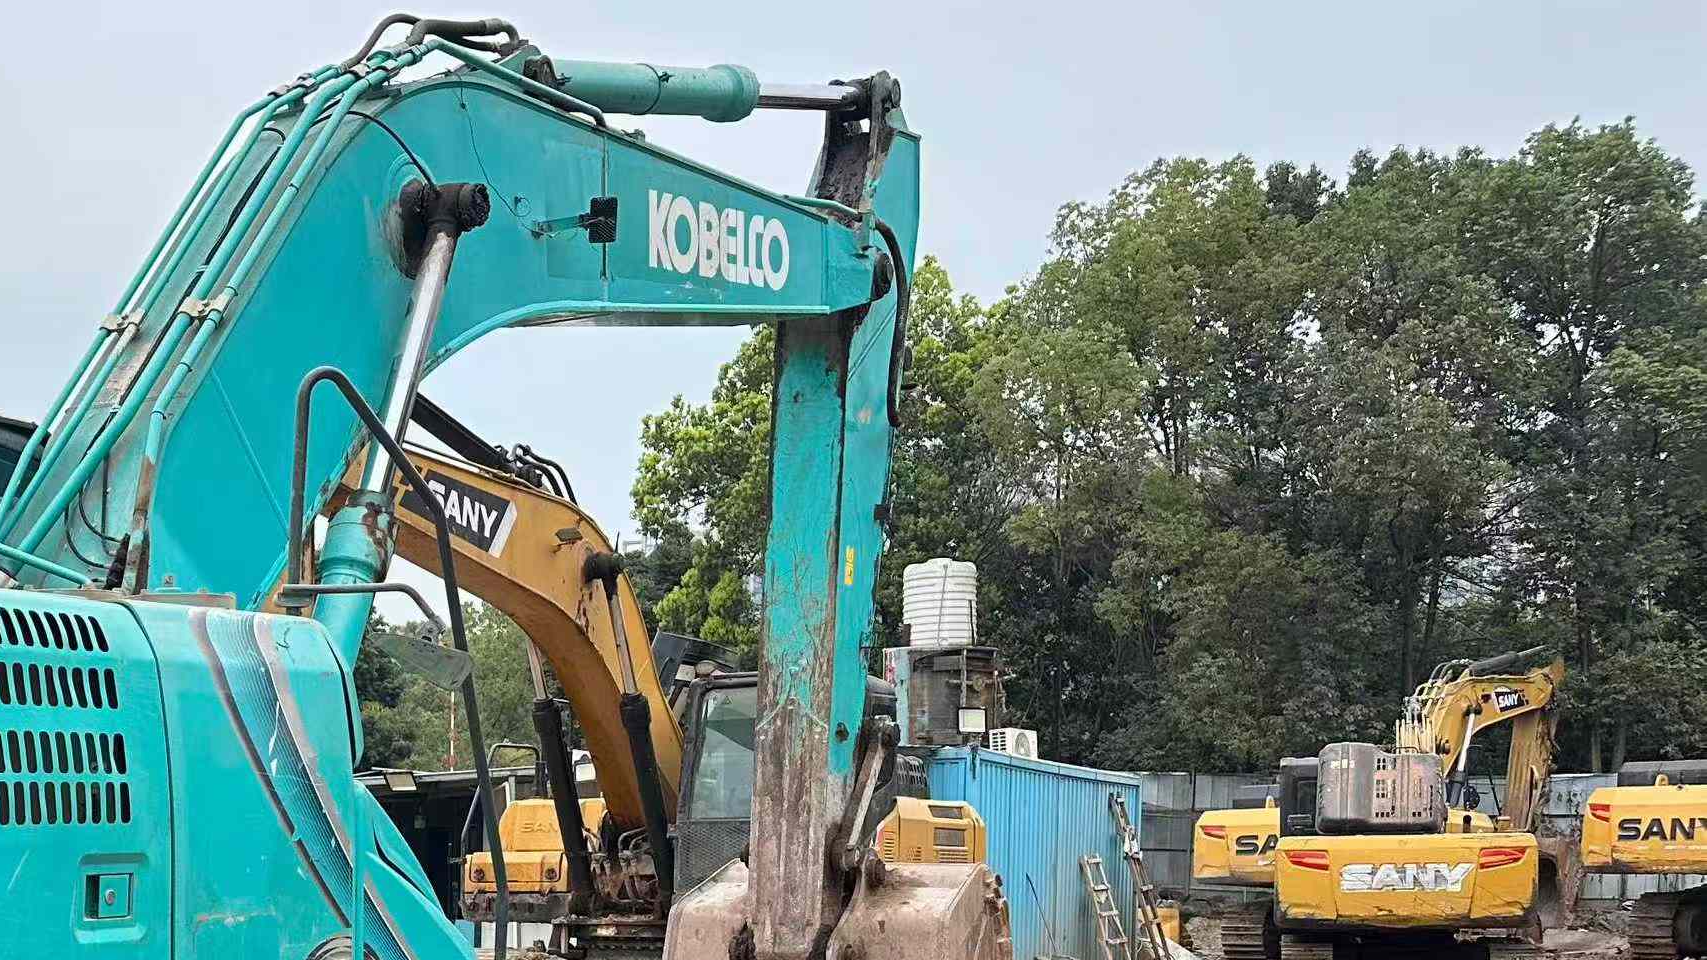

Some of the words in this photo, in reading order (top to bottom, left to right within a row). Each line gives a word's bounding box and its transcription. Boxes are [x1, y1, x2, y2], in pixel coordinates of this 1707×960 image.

[649, 190, 790, 291] KOBELCO
[1498, 693, 1519, 708] SANY
[520, 822, 558, 833] SAN
[1236, 834, 1279, 856] SA
[1340, 863, 1477, 892] SANY
